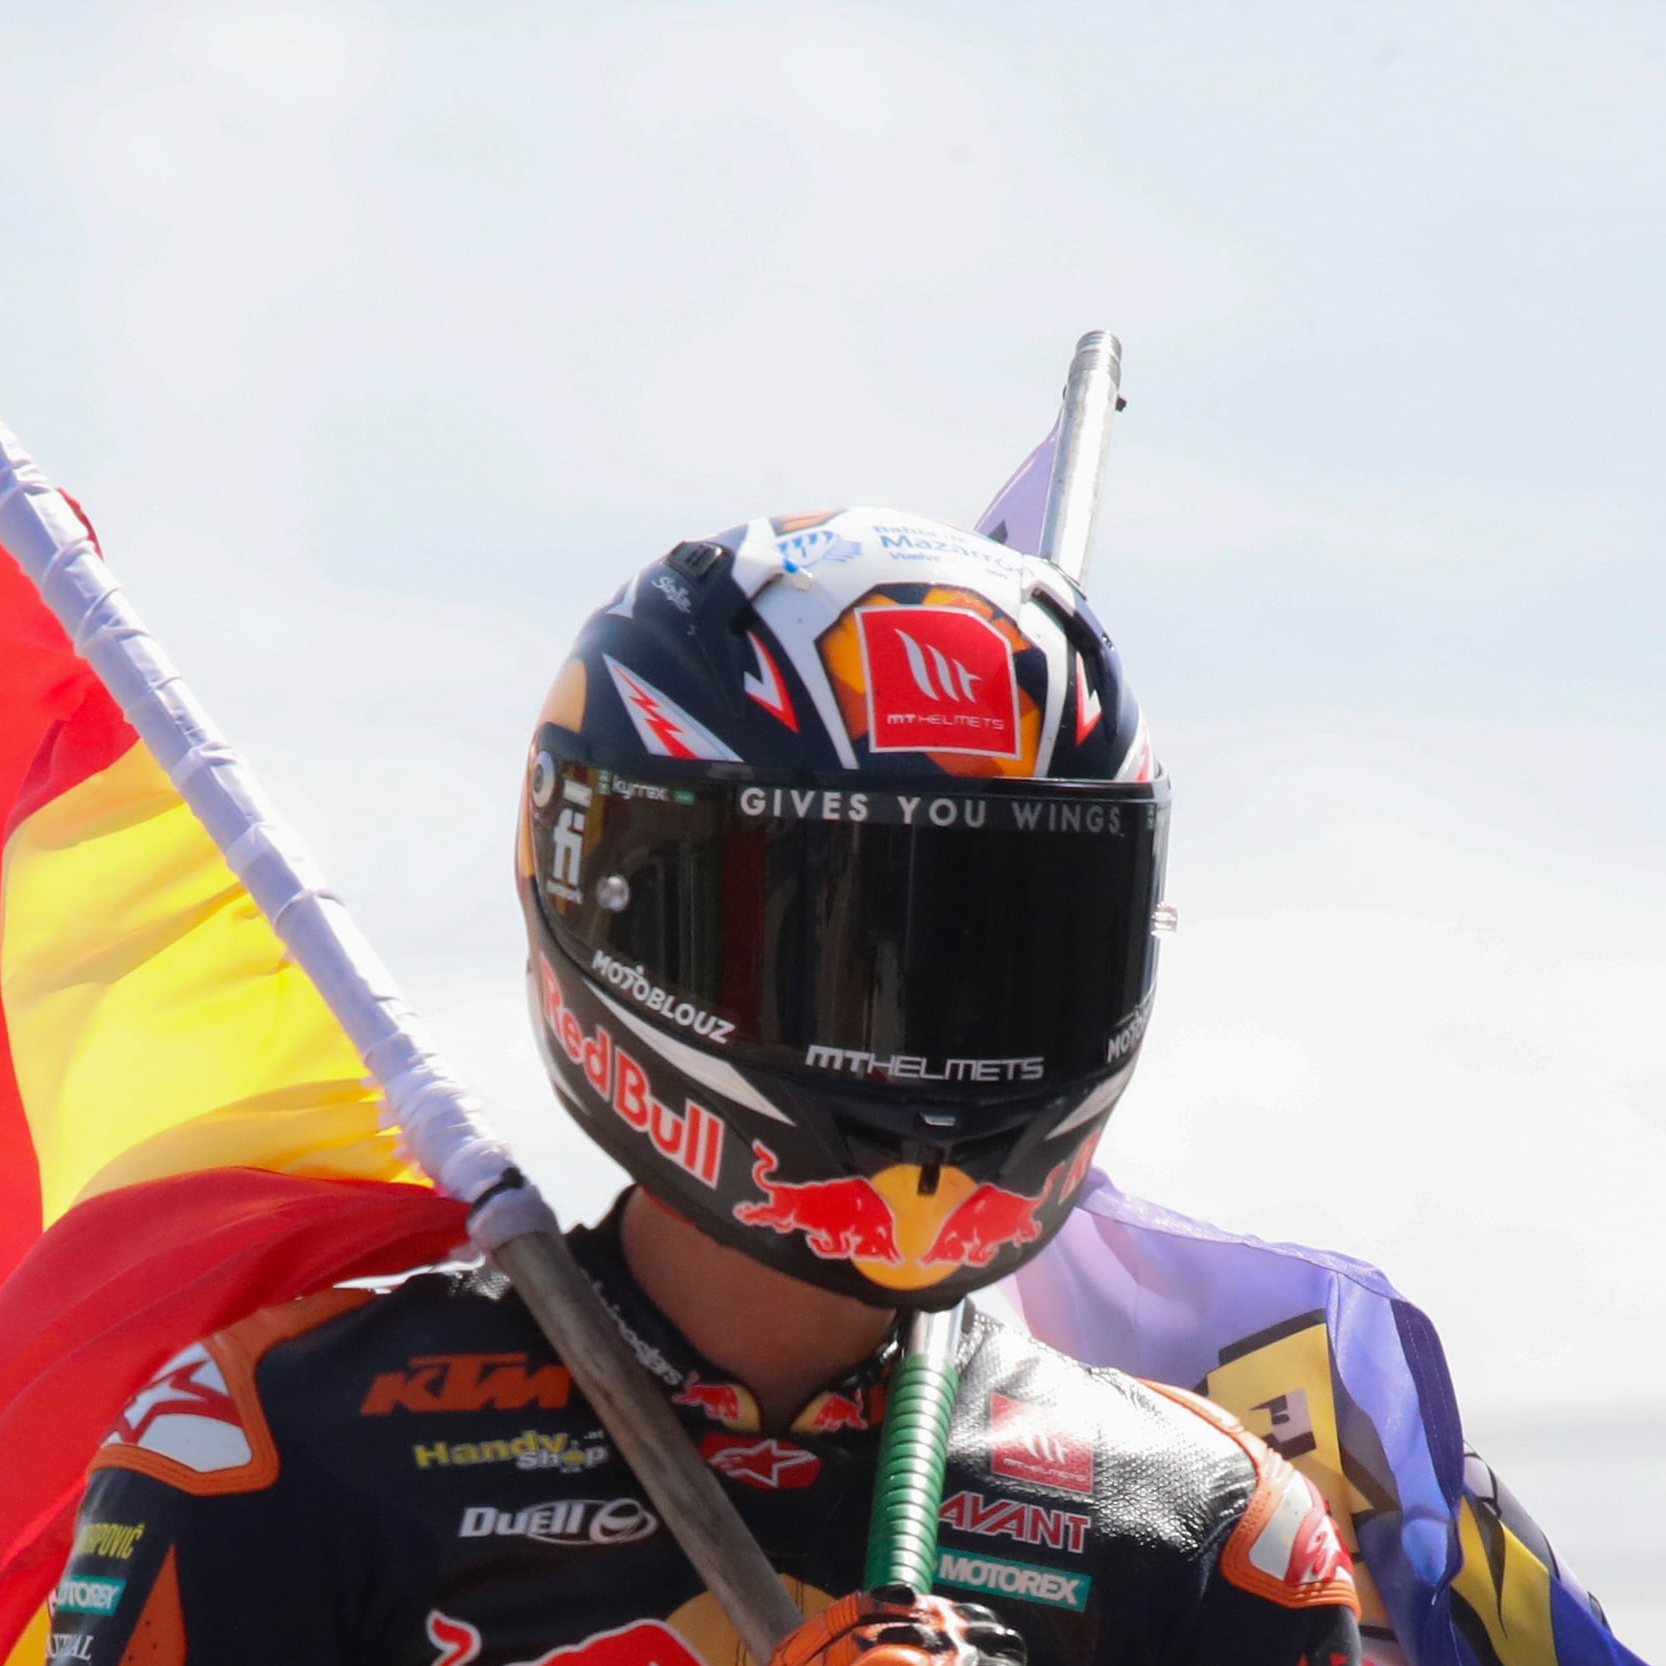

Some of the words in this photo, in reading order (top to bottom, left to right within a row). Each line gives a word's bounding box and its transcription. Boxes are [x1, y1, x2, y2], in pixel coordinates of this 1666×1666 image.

[739, 786, 869, 823] GIVES
[897, 796, 987, 828] YOU
[1011, 801, 1123, 834] WINGS
[590, 949, 736, 1045] MOTOBLOUZ
[538, 950, 612, 1104] Red
[613, 1045, 725, 1192] Bull
[359, 1352, 572, 1416] KTM
[412, 1430, 569, 1469] Handy
[939, 1491, 1091, 1554] AVANT
[939, 1553, 1085, 1606] MOTOREX
